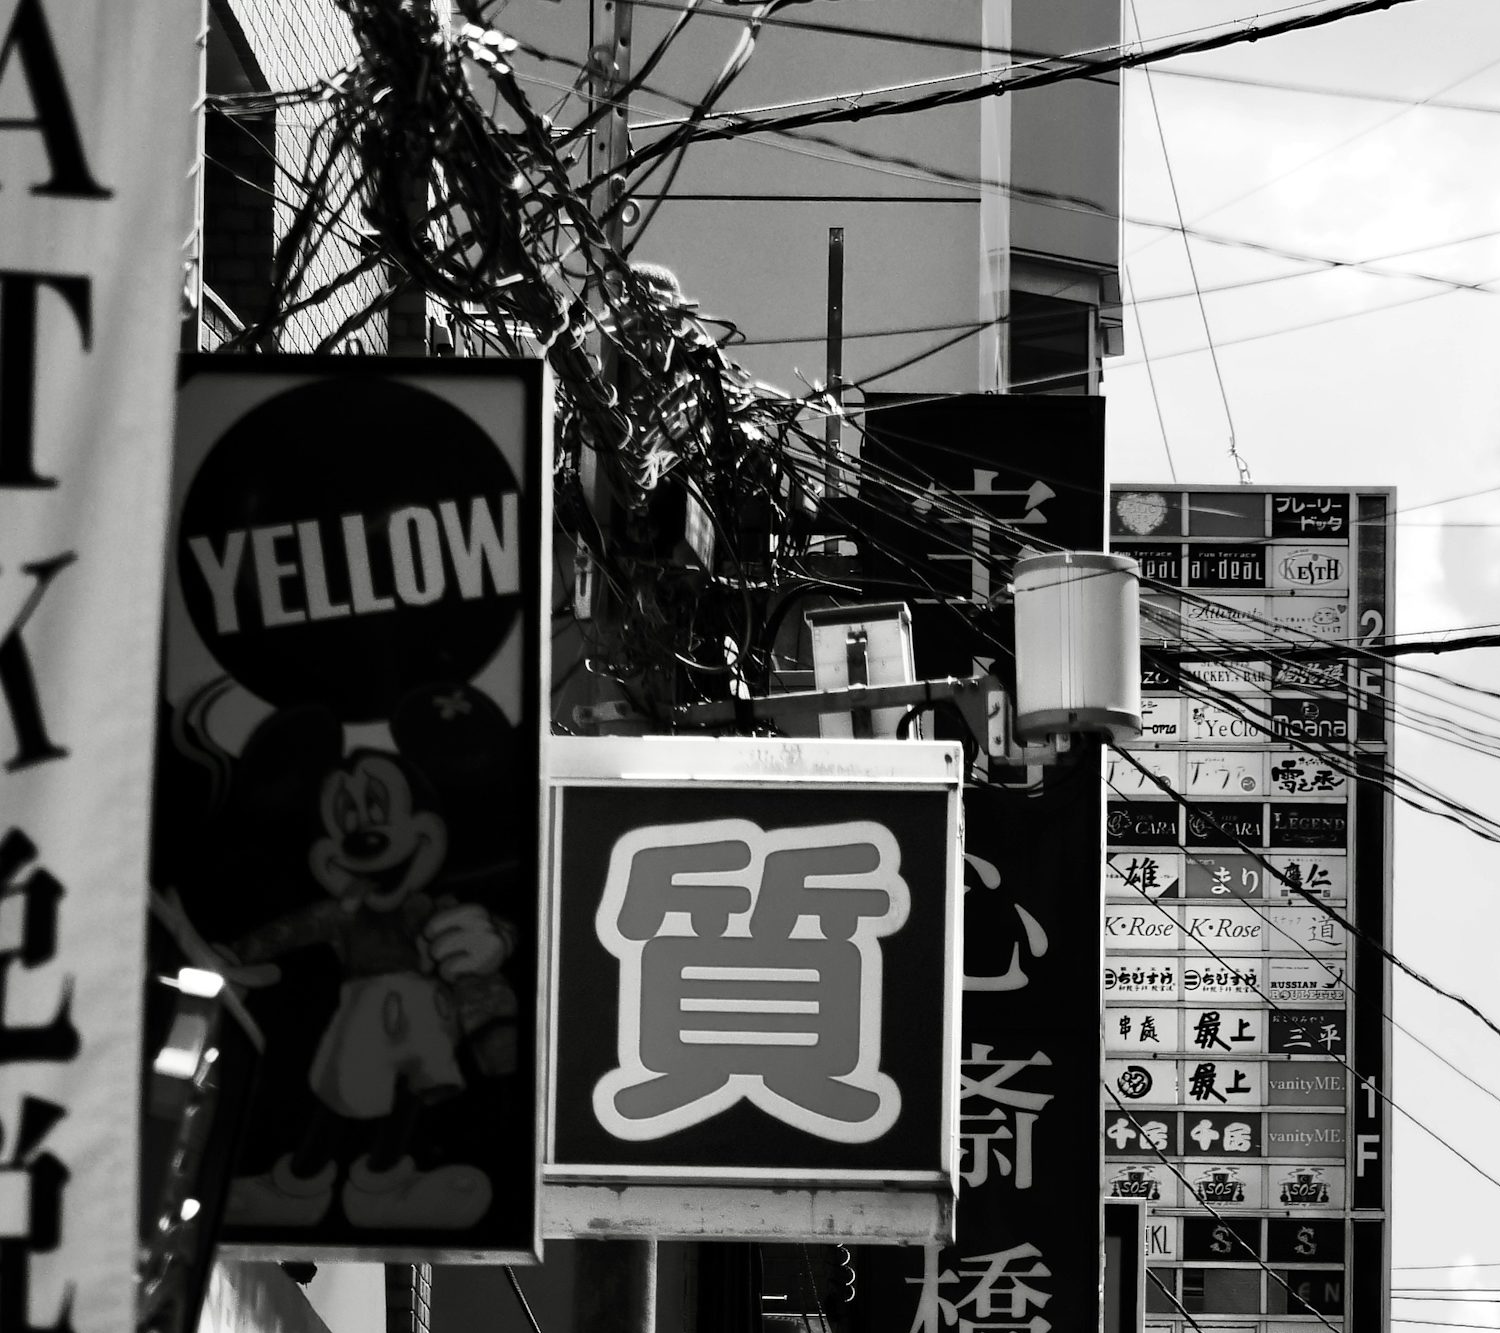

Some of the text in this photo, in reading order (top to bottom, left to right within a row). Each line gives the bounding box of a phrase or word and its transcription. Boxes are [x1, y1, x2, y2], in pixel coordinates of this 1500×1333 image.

[1276, 497, 1342, 513] プレーリー
[188, 492, 522, 634] YELLOW
[1135, 822, 1177, 835] CARA
[1273, 812, 1345, 831] LEGEND
[1123, 856, 1161, 892] 雄
[1210, 865, 1260, 894] まり
[1308, 915, 1343, 947] 道
[594, 820, 902, 1146] 質
[1270, 981, 1318, 989] RUSSIAN
[1193, 1011, 1256, 1051] 最上
[1283, 1023, 1342, 1050] 三平
[1188, 1062, 1252, 1104] 最上
[1356, 1075, 1381, 1178] 1F
[1121, 1181, 1149, 1194] SOS
[1205, 1182, 1232, 1196] SOS
[1290, 1182, 1318, 1196] SOS
